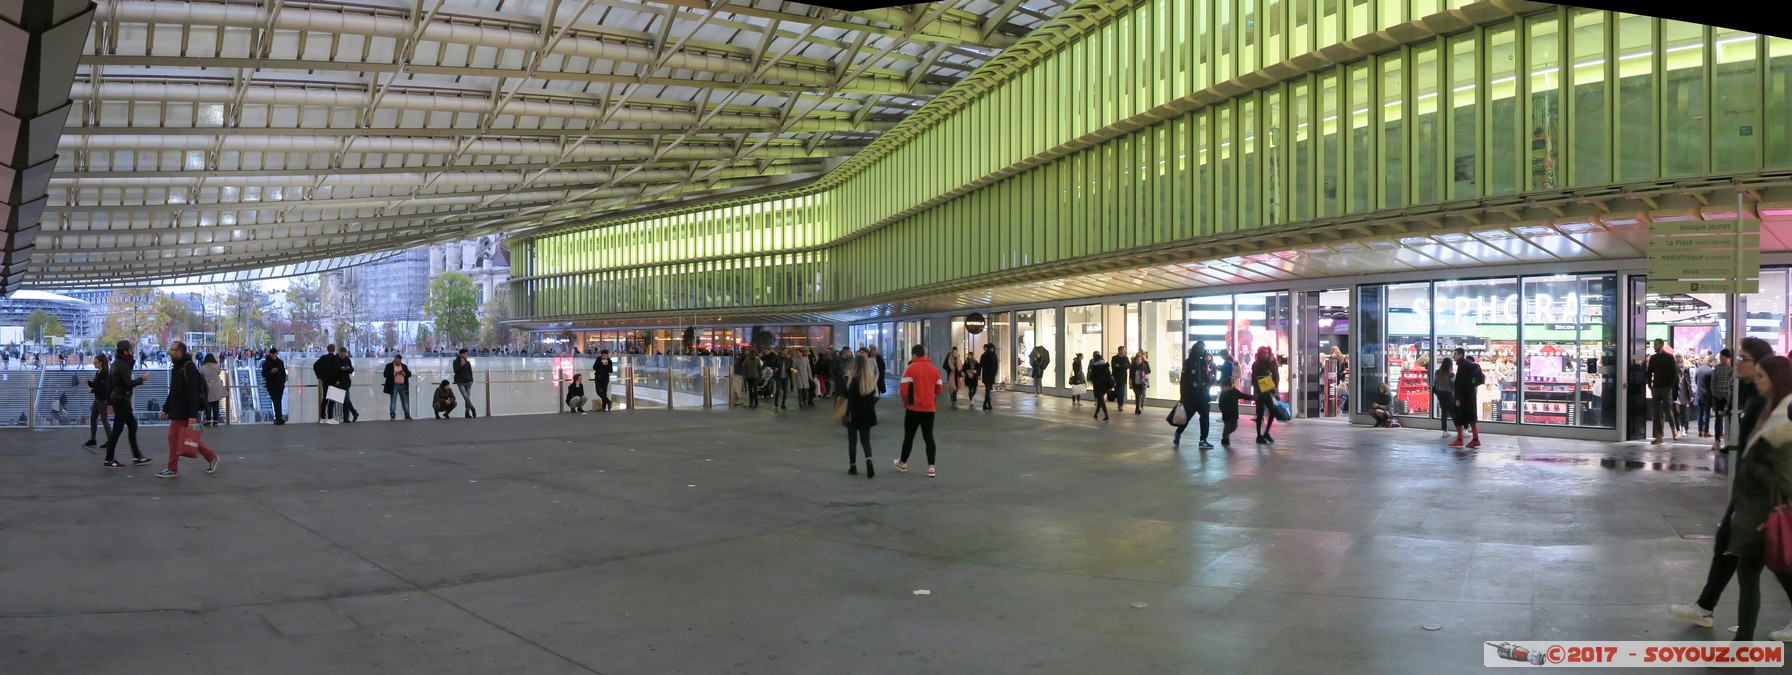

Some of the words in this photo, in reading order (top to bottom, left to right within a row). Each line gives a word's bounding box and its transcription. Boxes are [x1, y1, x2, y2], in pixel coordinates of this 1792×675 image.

[1708, 223, 1731, 231] jeunes
[1700, 283, 1730, 291] Parkings
[1412, 292, 1583, 329] SEPHORA
